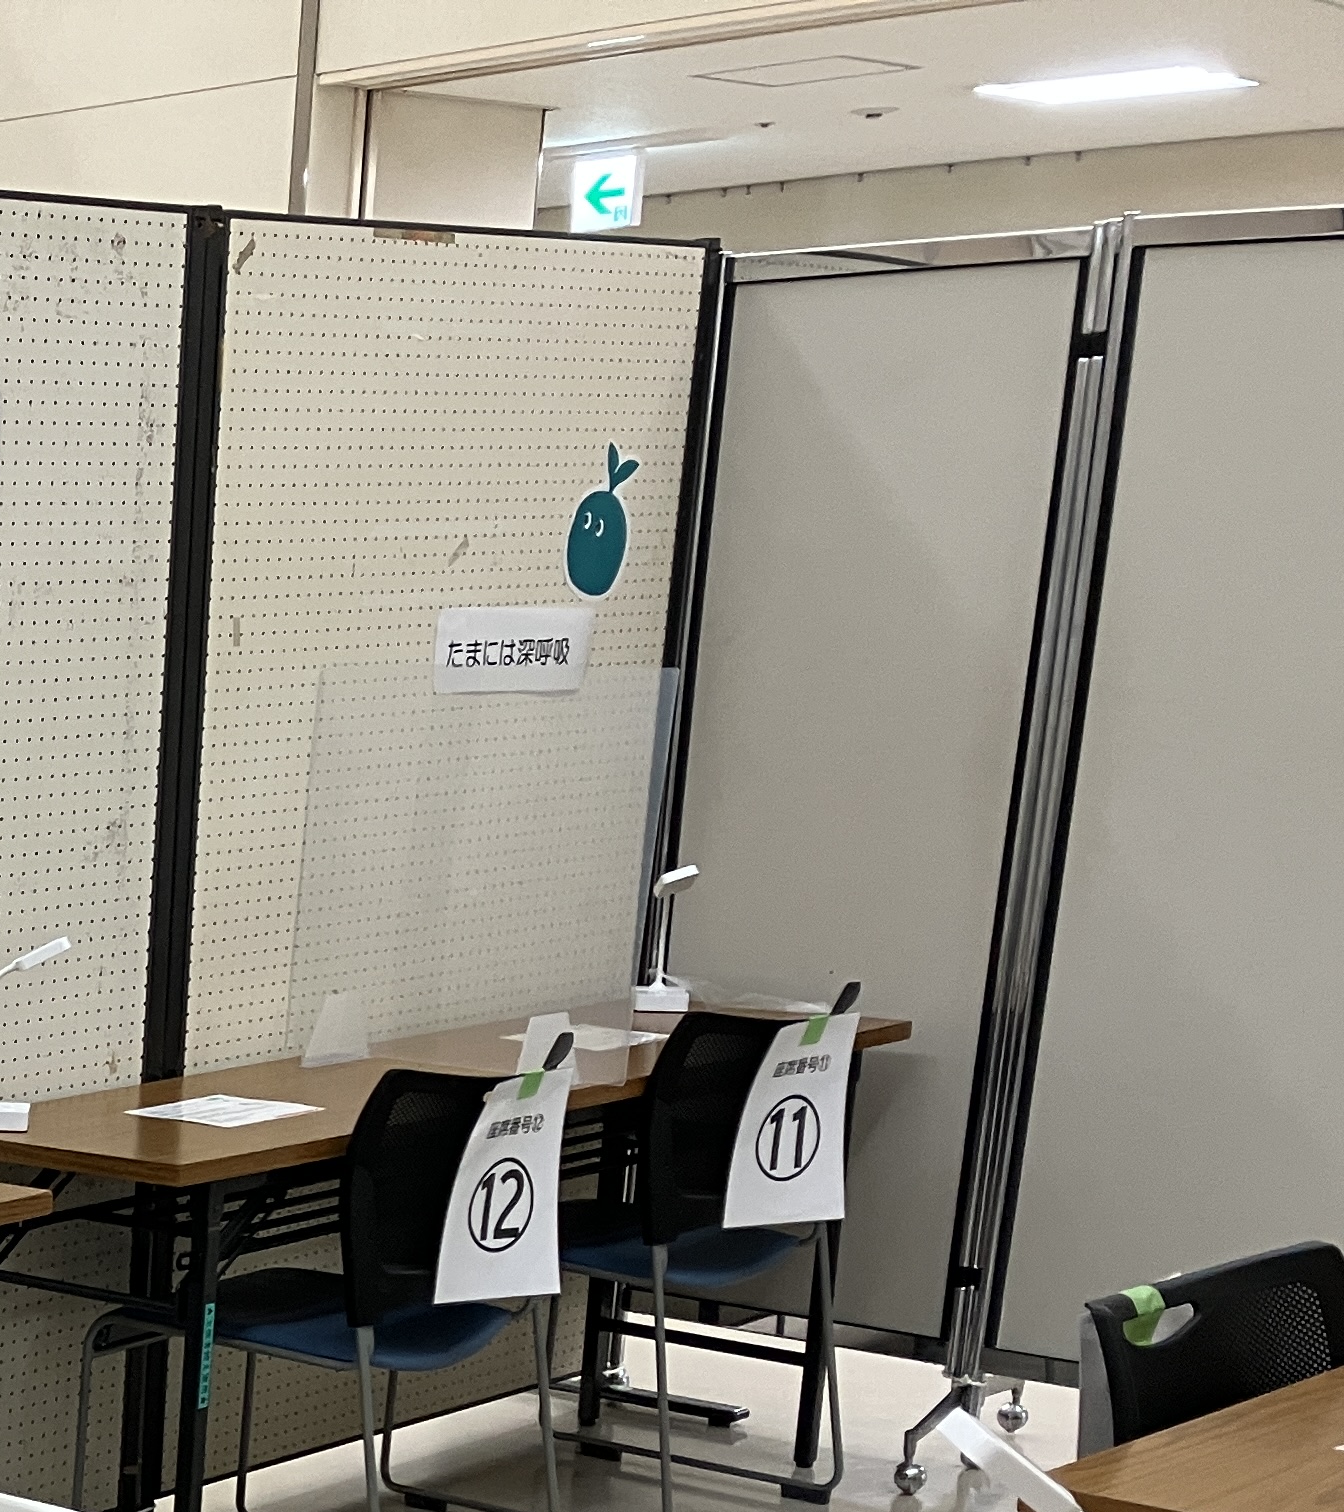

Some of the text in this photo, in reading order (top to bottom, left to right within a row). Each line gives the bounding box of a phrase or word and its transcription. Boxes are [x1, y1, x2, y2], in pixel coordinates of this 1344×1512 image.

[445, 637, 570, 668] たまには深呼吸
